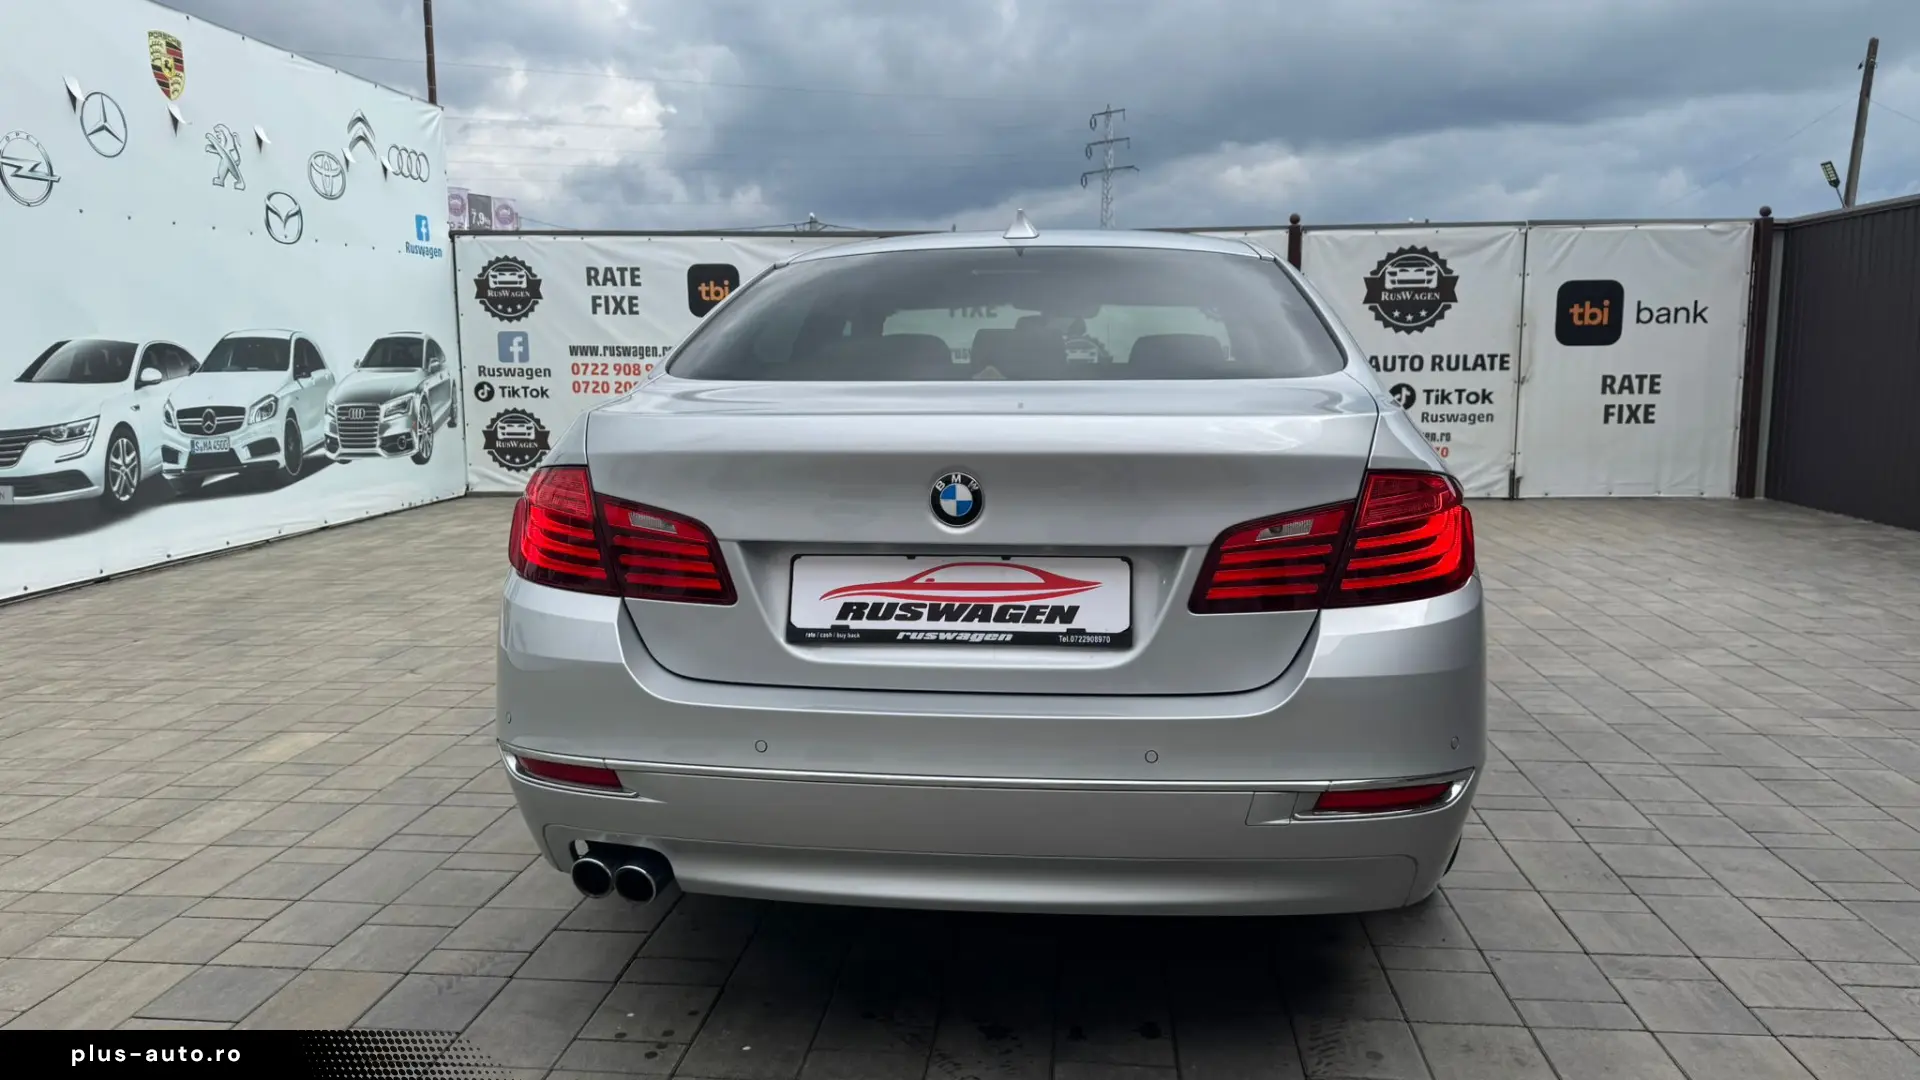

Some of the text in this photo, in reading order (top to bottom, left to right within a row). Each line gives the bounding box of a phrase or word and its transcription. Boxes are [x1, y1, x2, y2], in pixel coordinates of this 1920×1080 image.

[405, 240, 443, 259] Ruswagen
[586, 266, 642, 287] RATE
[697, 279, 730, 301] tbi
[591, 295, 640, 316] FIXE
[1569, 300, 1709, 326] tbi bank
[571, 363, 609, 376] 0722
[613, 363, 641, 376] 908
[1368, 353, 1510, 372] AUTO RULATE
[477, 365, 552, 380] Ruswagen
[498, 386, 551, 399] TikTok
[572, 381, 639, 394] 0720 20
[1601, 374, 1662, 395] RATE
[1422, 388, 1495, 405] TikTok
[1421, 411, 1495, 426] Ruswagen
[1603, 404, 1656, 425] FIXE
[935, 474, 980, 491] BMW
[835, 601, 1081, 625] RUSWAGEN
[896, 631, 1014, 642] ruswagen
